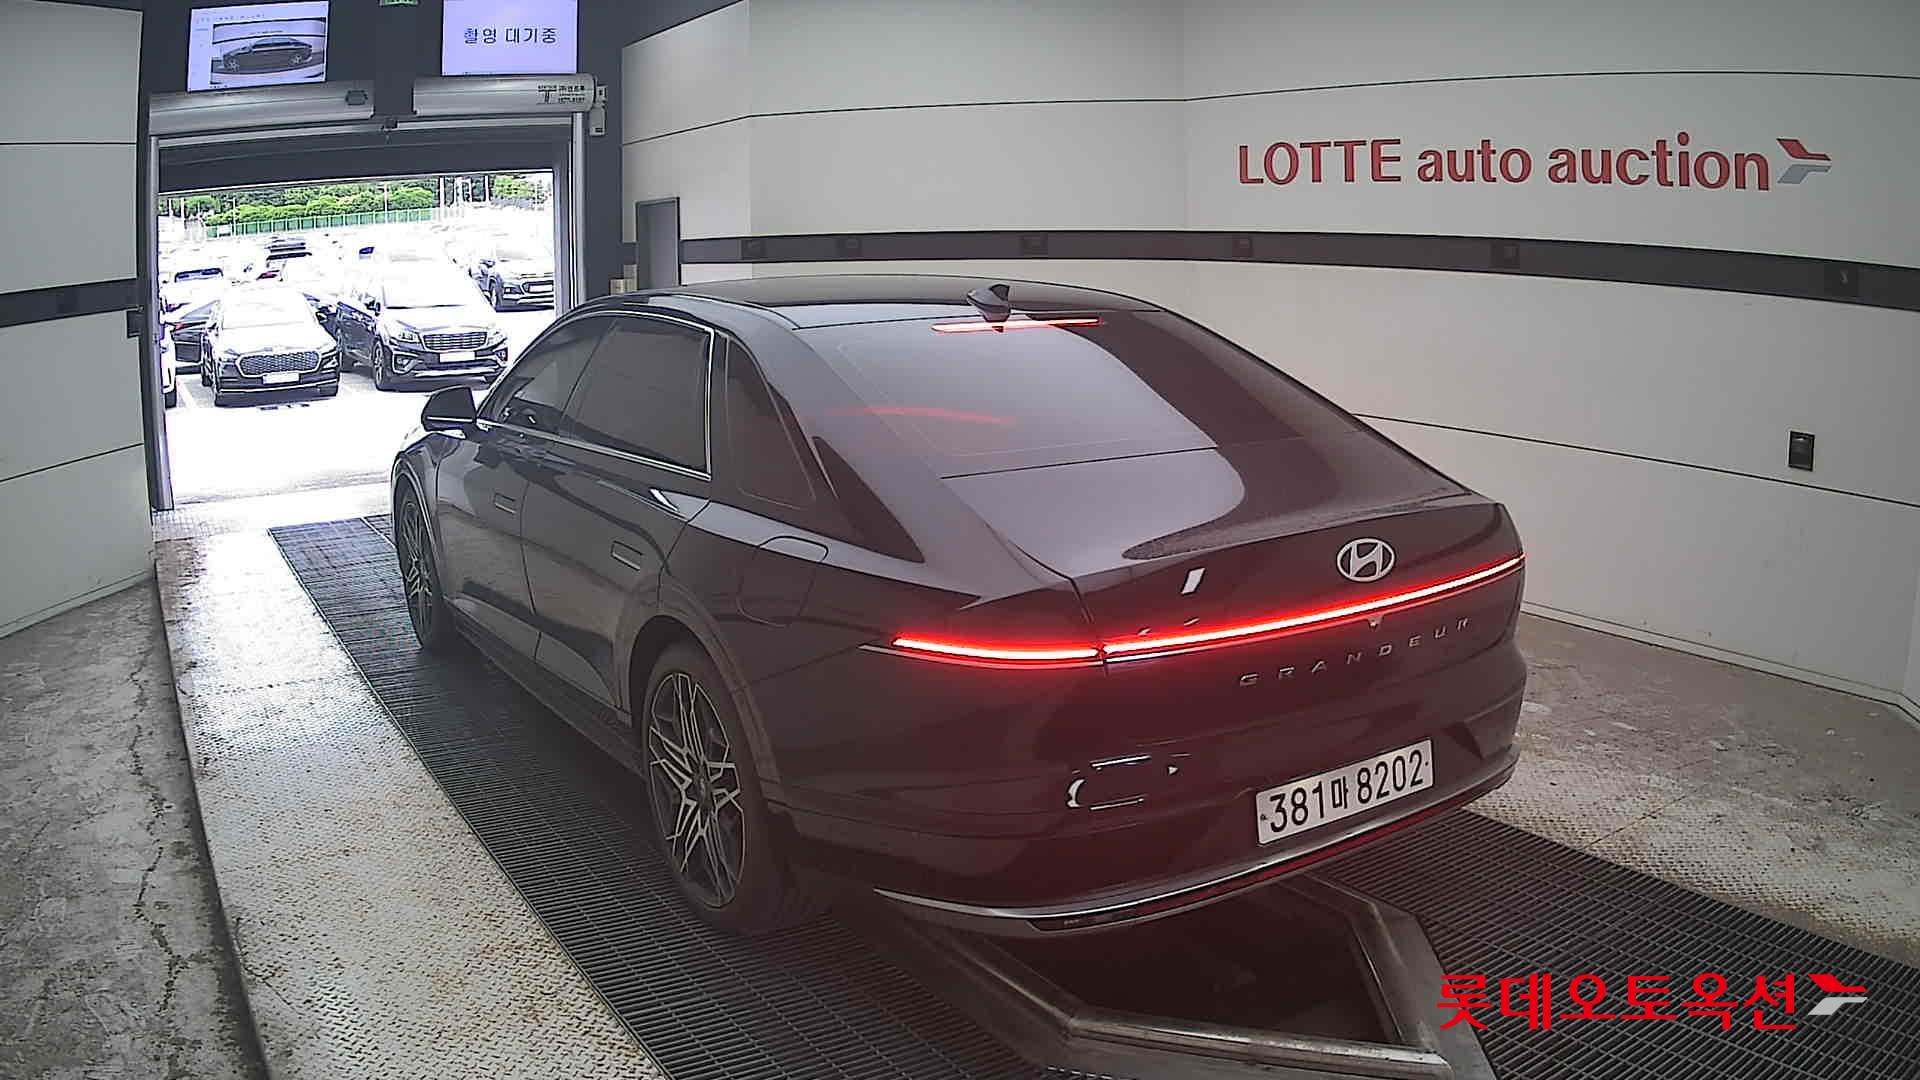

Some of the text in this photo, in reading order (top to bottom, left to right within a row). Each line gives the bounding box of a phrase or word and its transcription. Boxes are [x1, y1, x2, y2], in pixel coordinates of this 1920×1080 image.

[464, 27, 557, 44] 촬영 대기중
[1238, 131, 1770, 192] LOTTE auto auction
[1238, 616, 1470, 687] GRANDEUR
[1356, 749, 1424, 805] 8202
